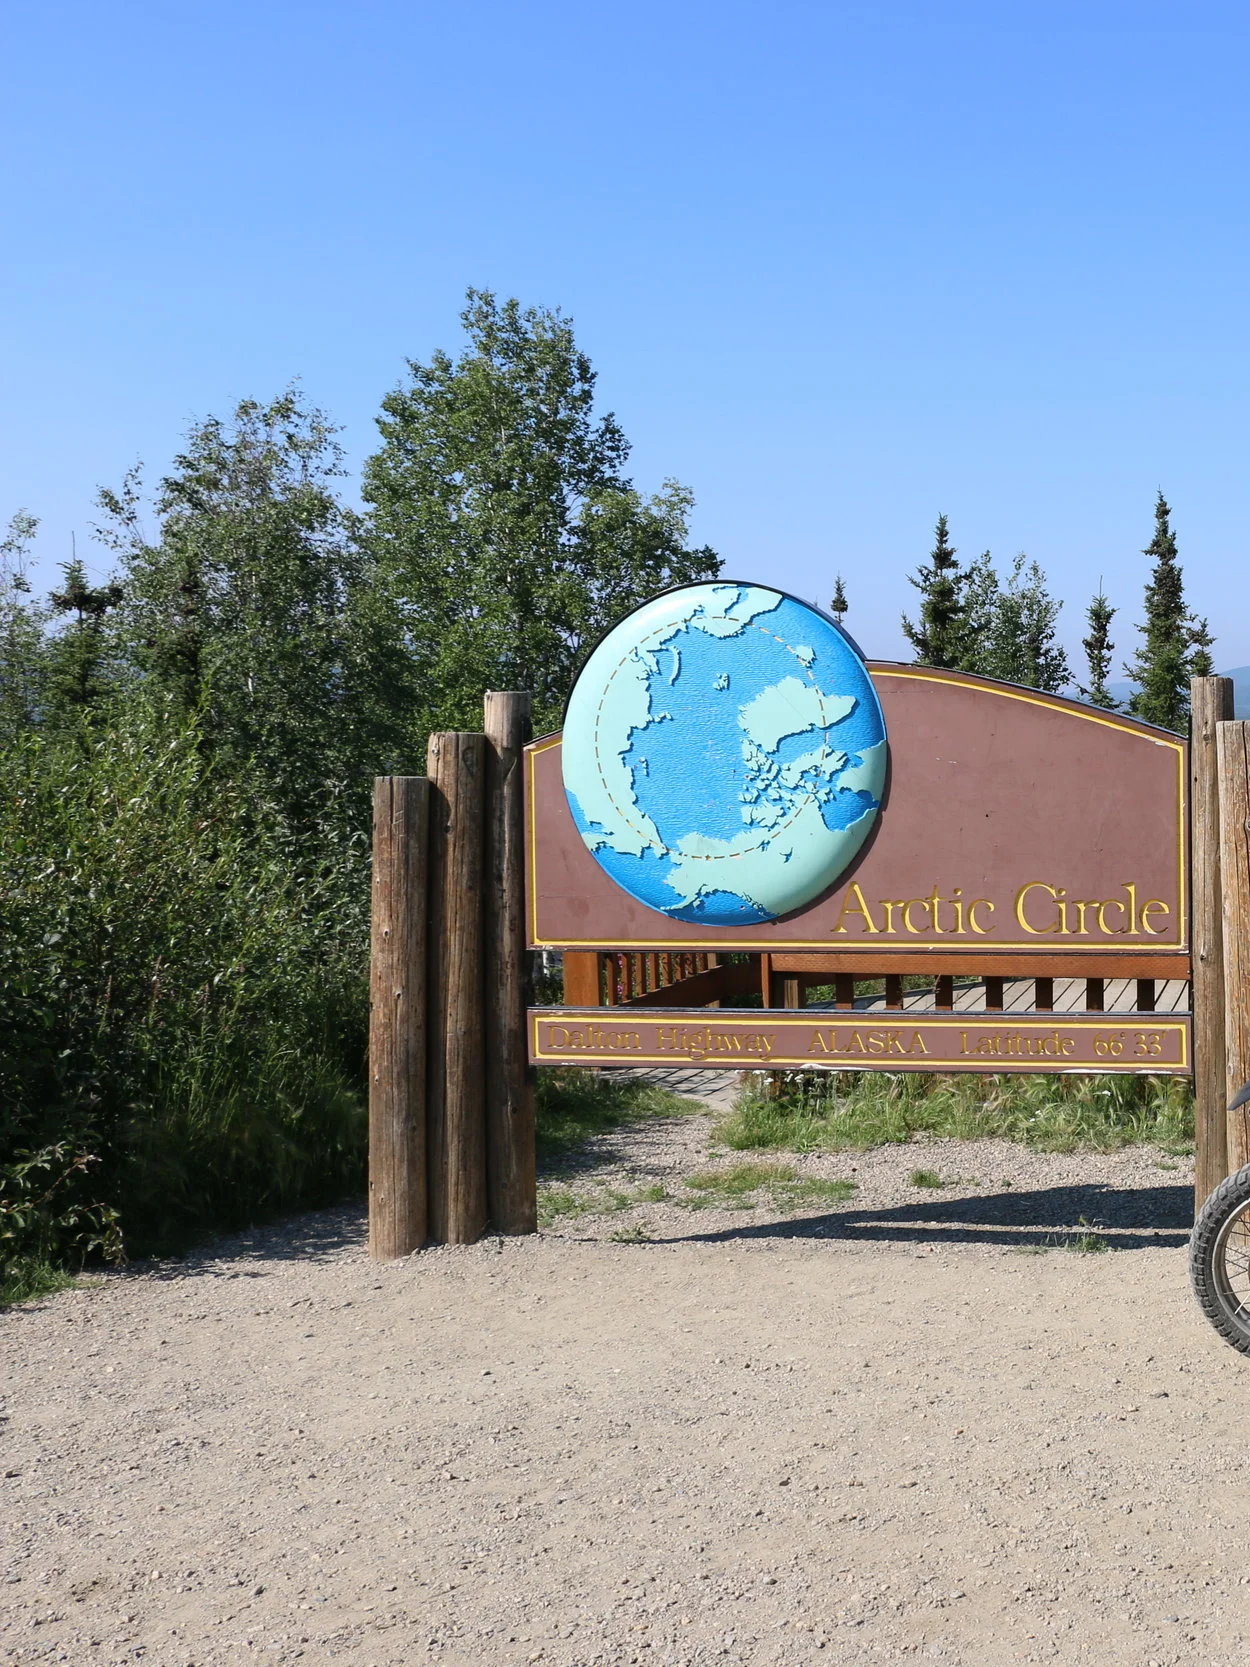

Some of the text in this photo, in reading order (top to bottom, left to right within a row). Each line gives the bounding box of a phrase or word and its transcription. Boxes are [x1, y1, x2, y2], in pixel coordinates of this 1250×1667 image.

[831, 881, 1170, 935] Arctic Circle
[548, 1025, 642, 1049] Dalton
[655, 1027, 776, 1061] Highway
[808, 1029, 932, 1054] ALASKA
[960, 1031, 1075, 1056] Latitude
